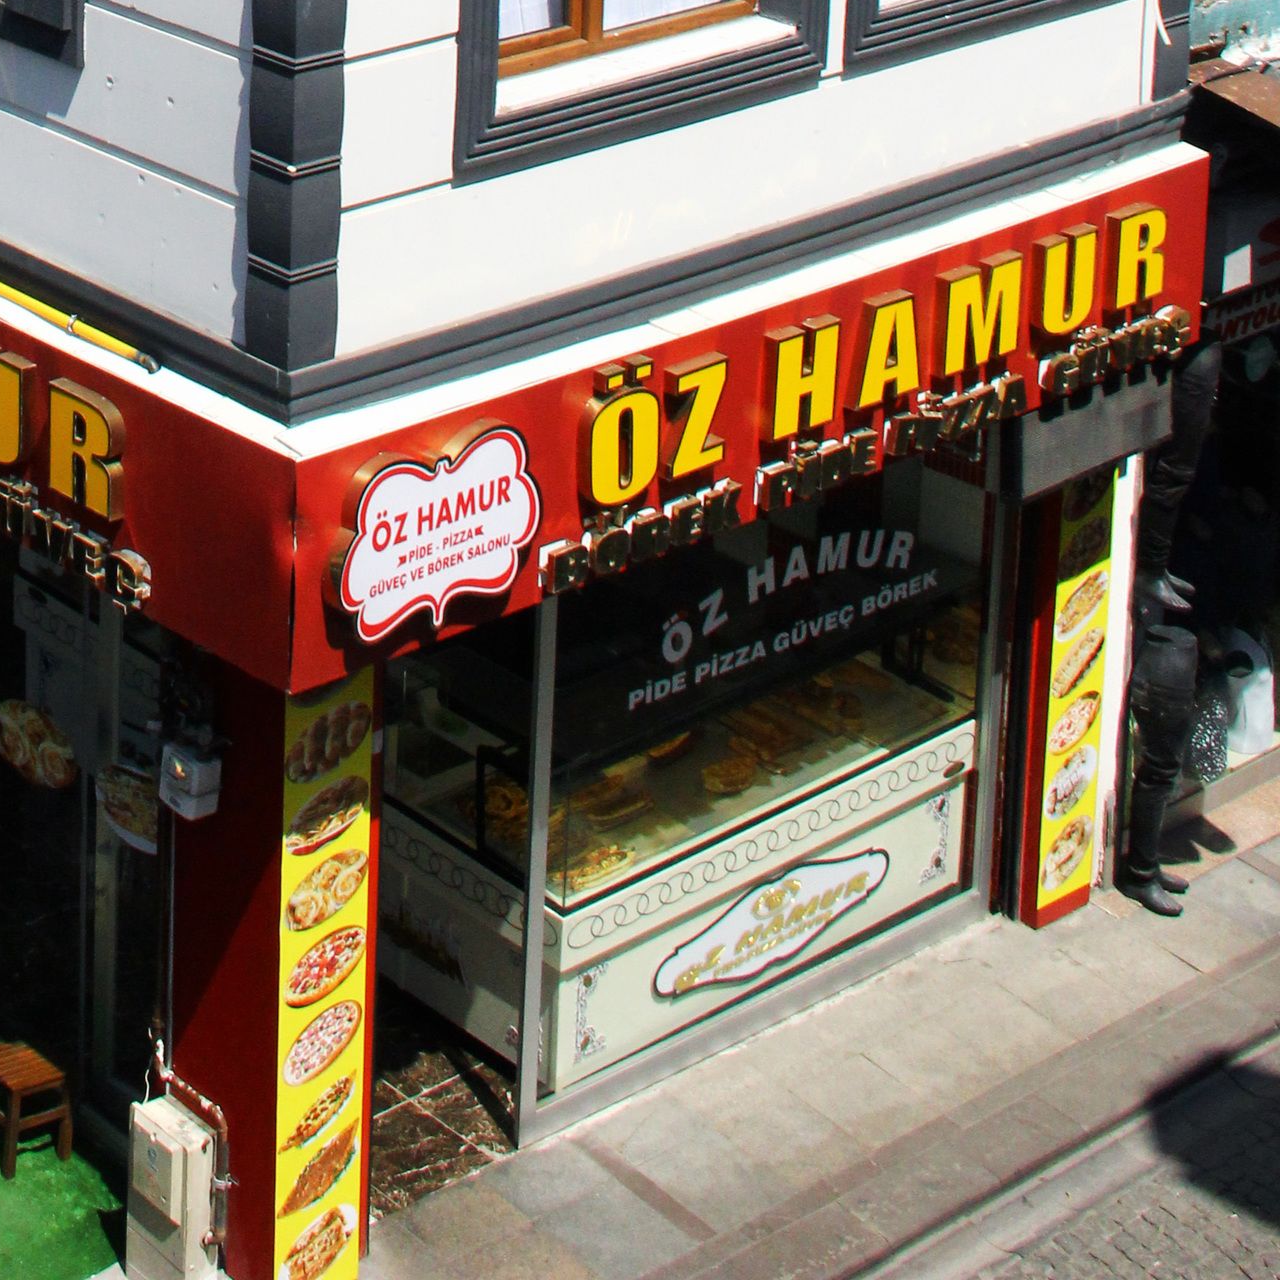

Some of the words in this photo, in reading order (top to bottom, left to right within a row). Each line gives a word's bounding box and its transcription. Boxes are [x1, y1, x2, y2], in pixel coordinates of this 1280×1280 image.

[582, 355, 727, 506] ÖZ
[765, 202, 1168, 441] HAMUR
[370, 574, 407, 598] GÜVEÇ
[410, 568, 424, 584] VE
[427, 553, 464, 576] BÖREK
[467, 533, 511, 560] SALONU
[372, 510, 409, 552] ÖZ
[417, 475, 511, 535] HAMUR
[409, 541, 433, 563] PİDE
[443, 529, 473, 554] PİZZA
[628, 671, 687, 711] PİDE
[695, 640, 767, 684] PİZZA
[773, 605, 854, 653] GÜVEÇ
[861, 568, 938, 617] BÖREK
[661, 589, 729, 663] ÖZ
[747, 529, 914, 605] HAMUR
